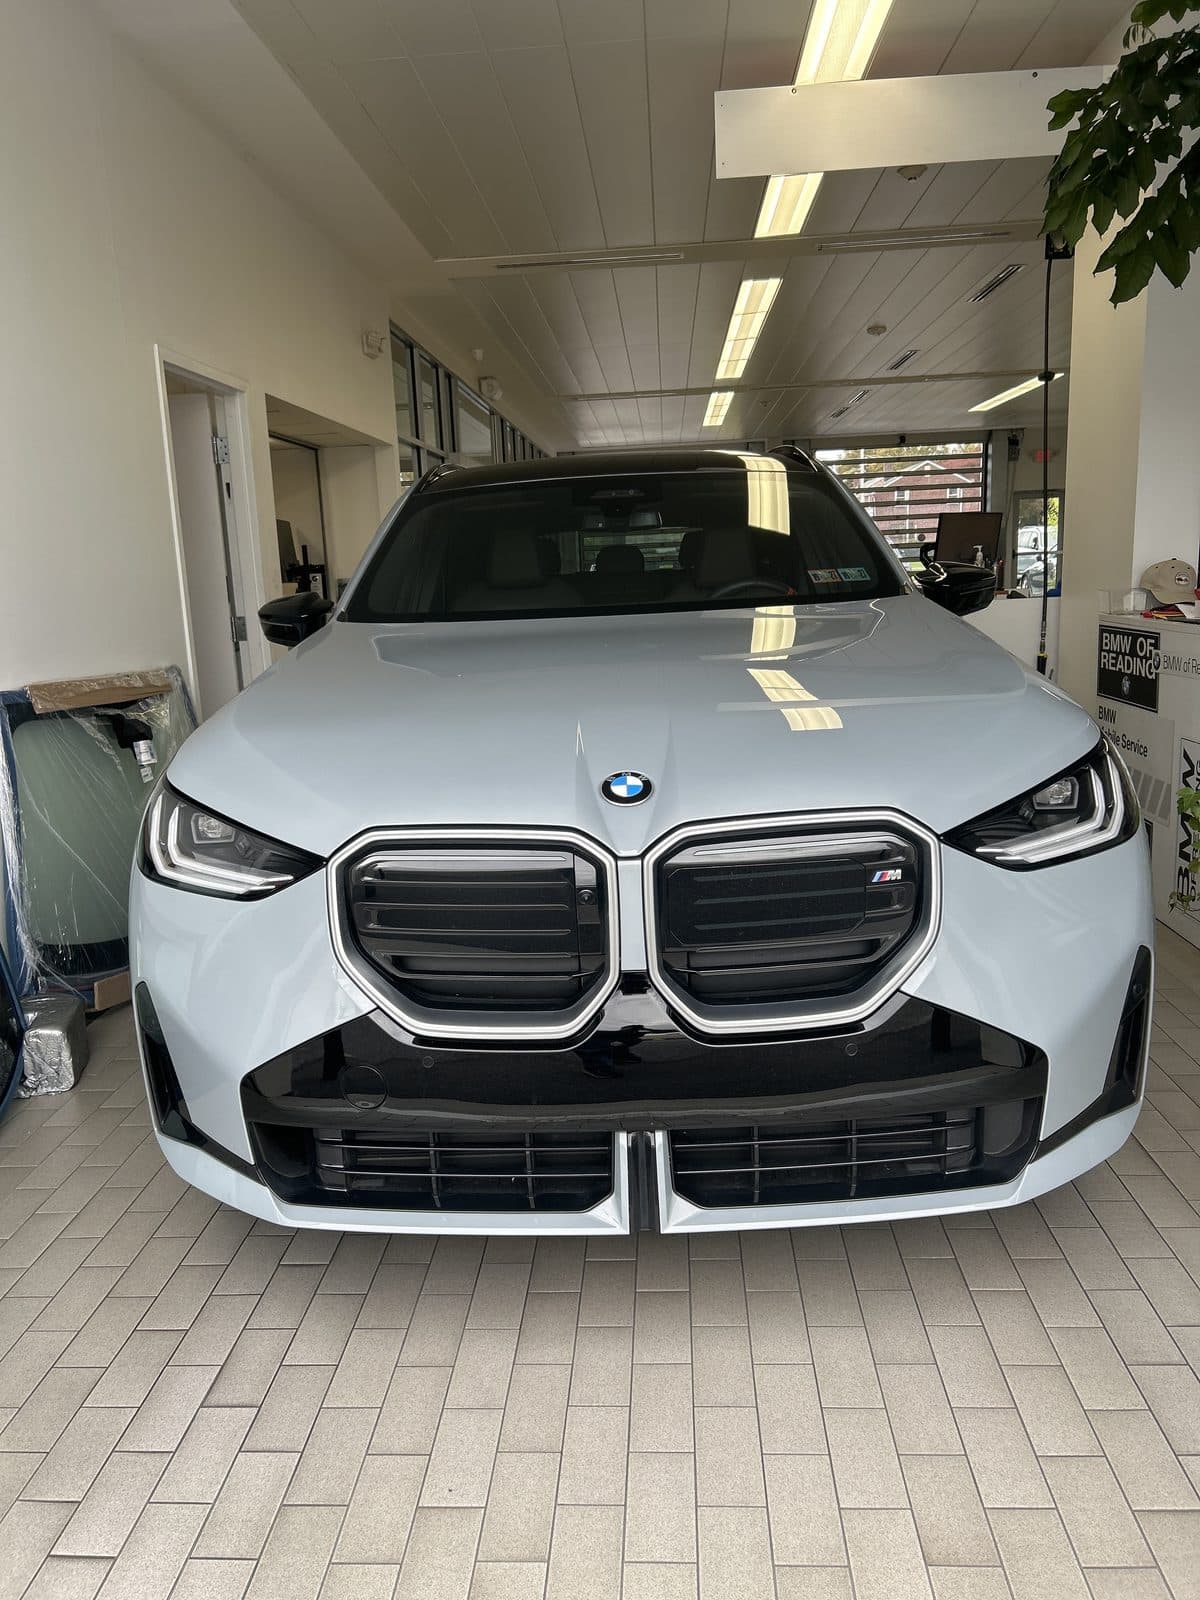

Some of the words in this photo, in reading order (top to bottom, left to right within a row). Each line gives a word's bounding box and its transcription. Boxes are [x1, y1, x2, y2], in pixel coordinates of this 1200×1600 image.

[1102, 632, 1132, 654] BMW
[1136, 637, 1155, 657] OF
[1100, 651, 1156, 680] READING
[1163, 654, 1182, 671] BMW
[1183, 658, 1191, 672] of
[1098, 705, 1117, 724] BMW
[1121, 733, 1148, 757] Service
